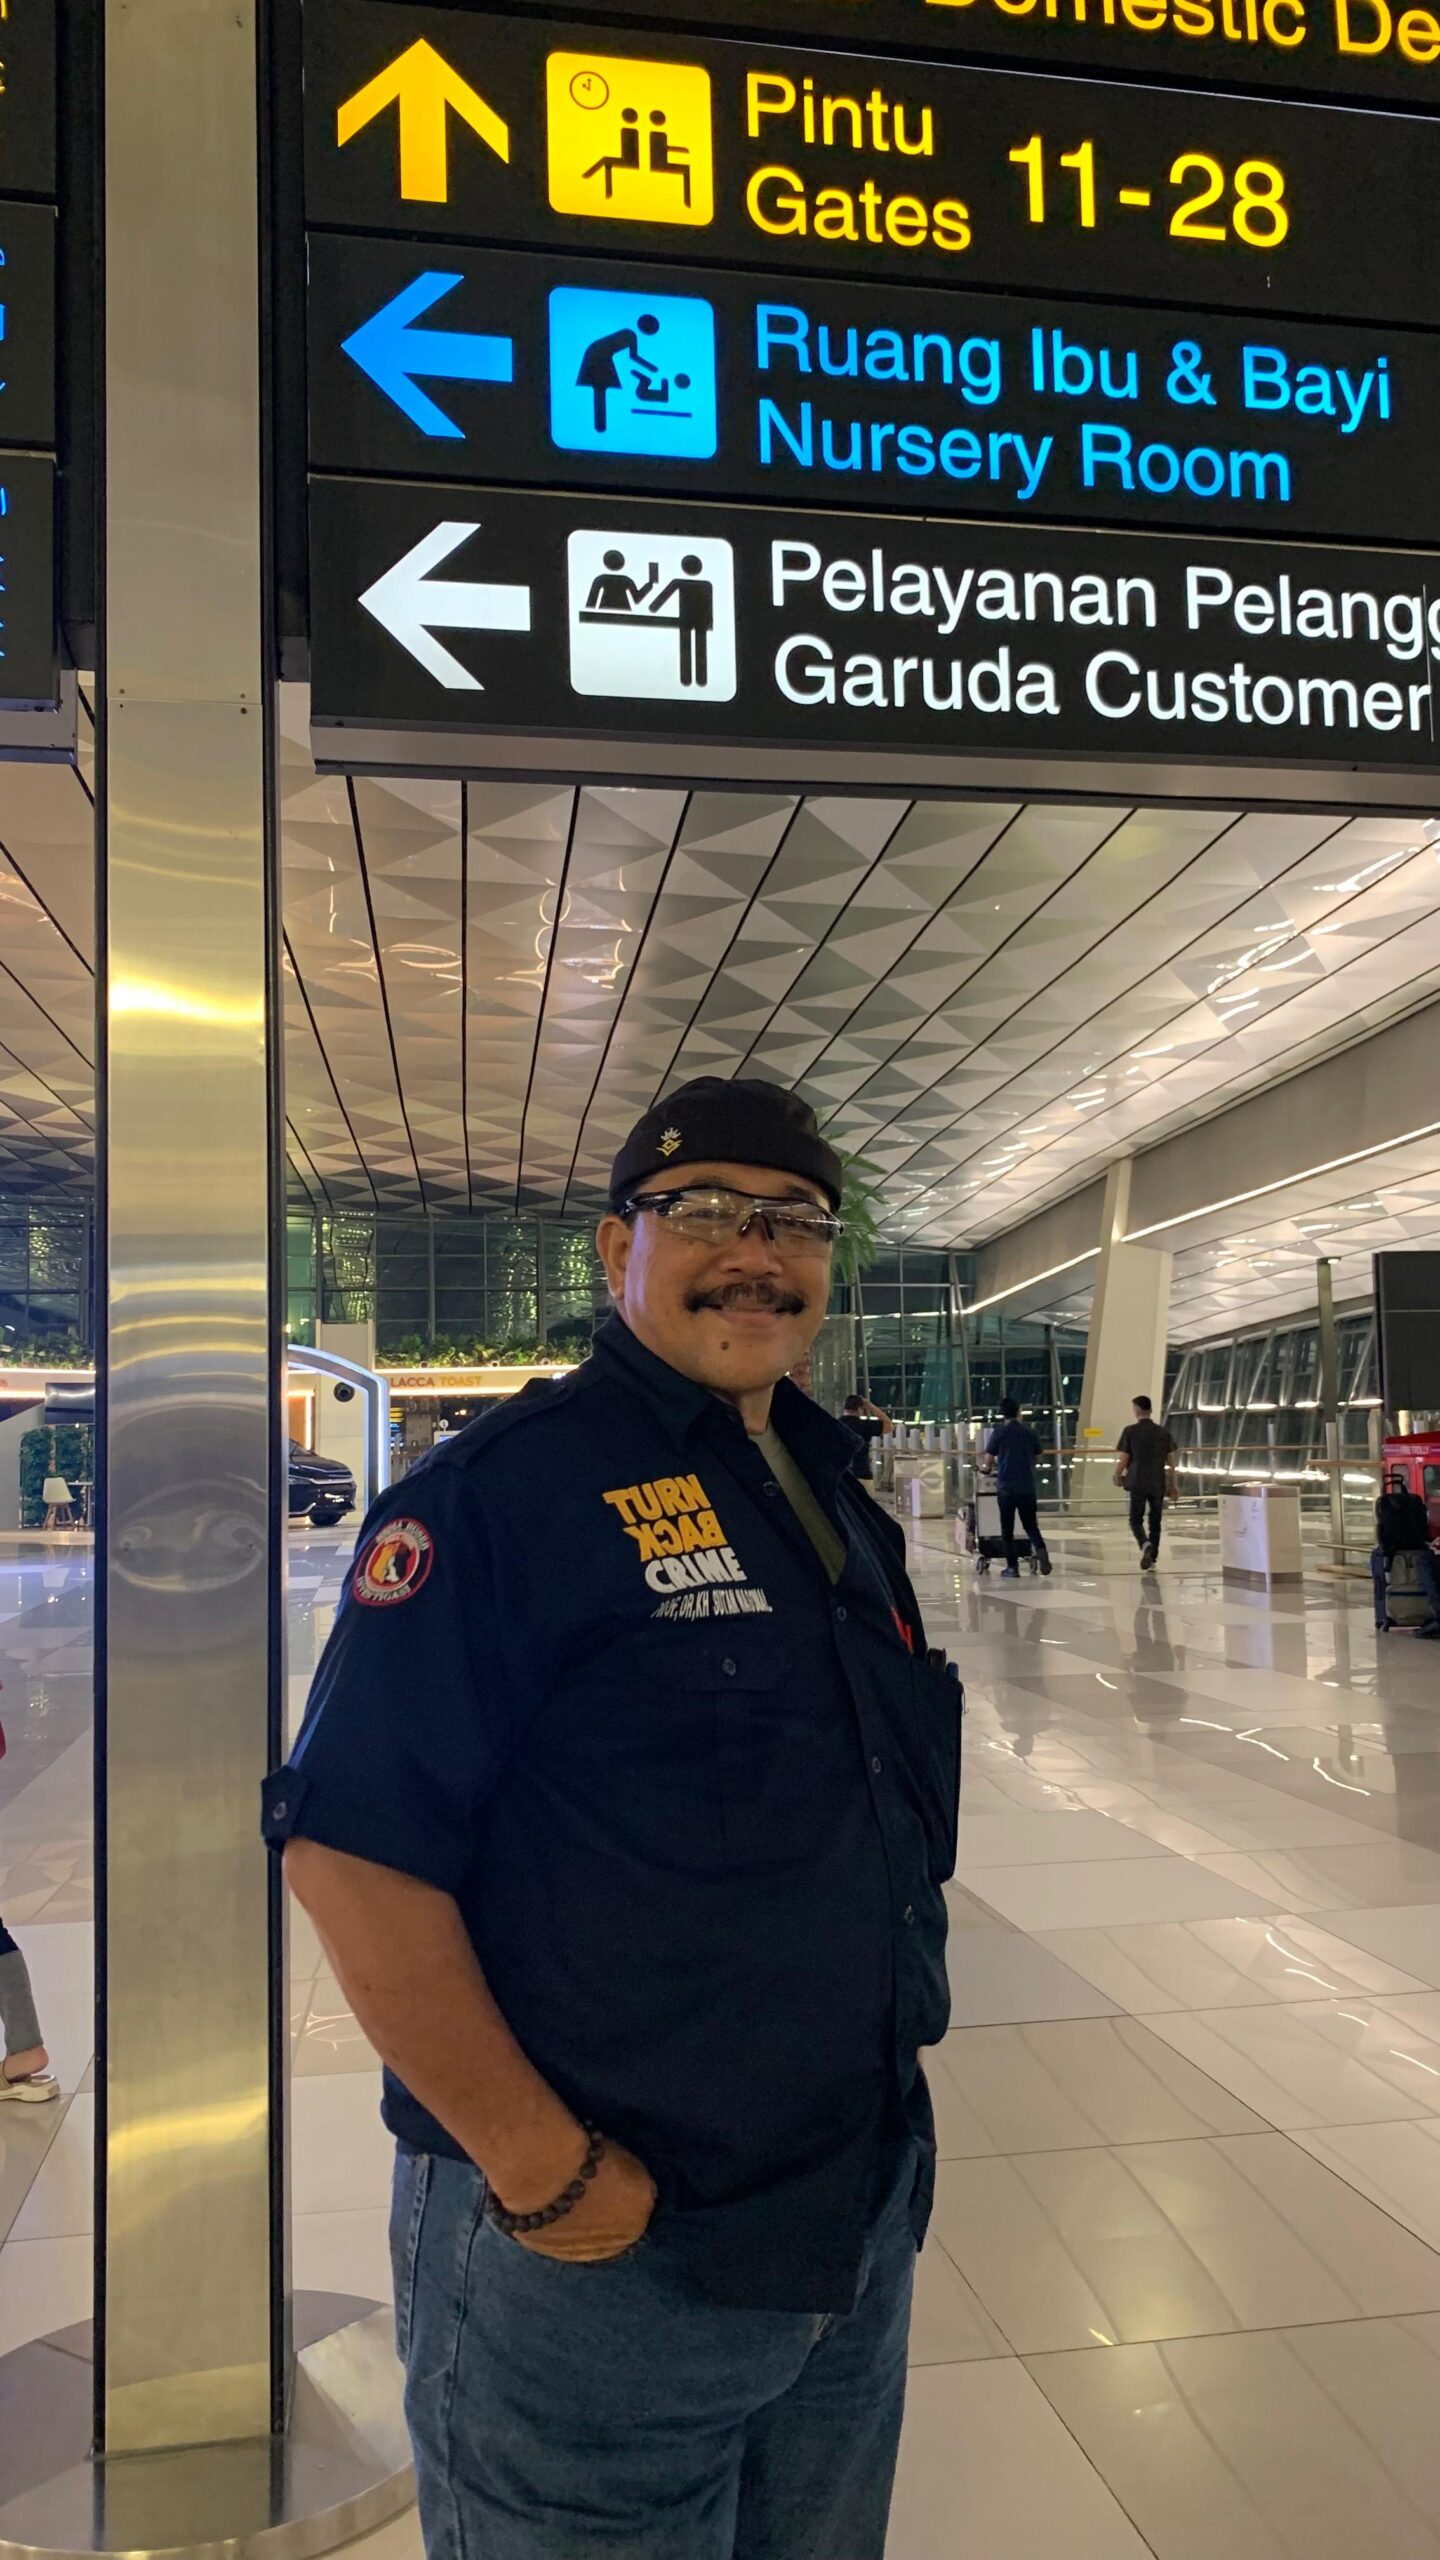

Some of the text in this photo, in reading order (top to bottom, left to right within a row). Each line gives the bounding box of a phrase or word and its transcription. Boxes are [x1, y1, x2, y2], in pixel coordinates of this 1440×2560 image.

[926, 0, 1440, 63] estic De
[747, 72, 933, 155] Pintu
[747, 165, 971, 250] Gates
[1009, 135, 1288, 247] 11-28
[756, 303, 1390, 433] Ruang Ibu & Bayi
[759, 398, 1290, 501] Nursery Room
[772, 540, 1440, 660] Pelayanan Pelang
[775, 634, 1431, 731] Garuda Customer
[439, 1375, 482, 1387] TOAST
[602, 1473, 712, 1525] TURN
[645, 1547, 748, 1594] CRIME
